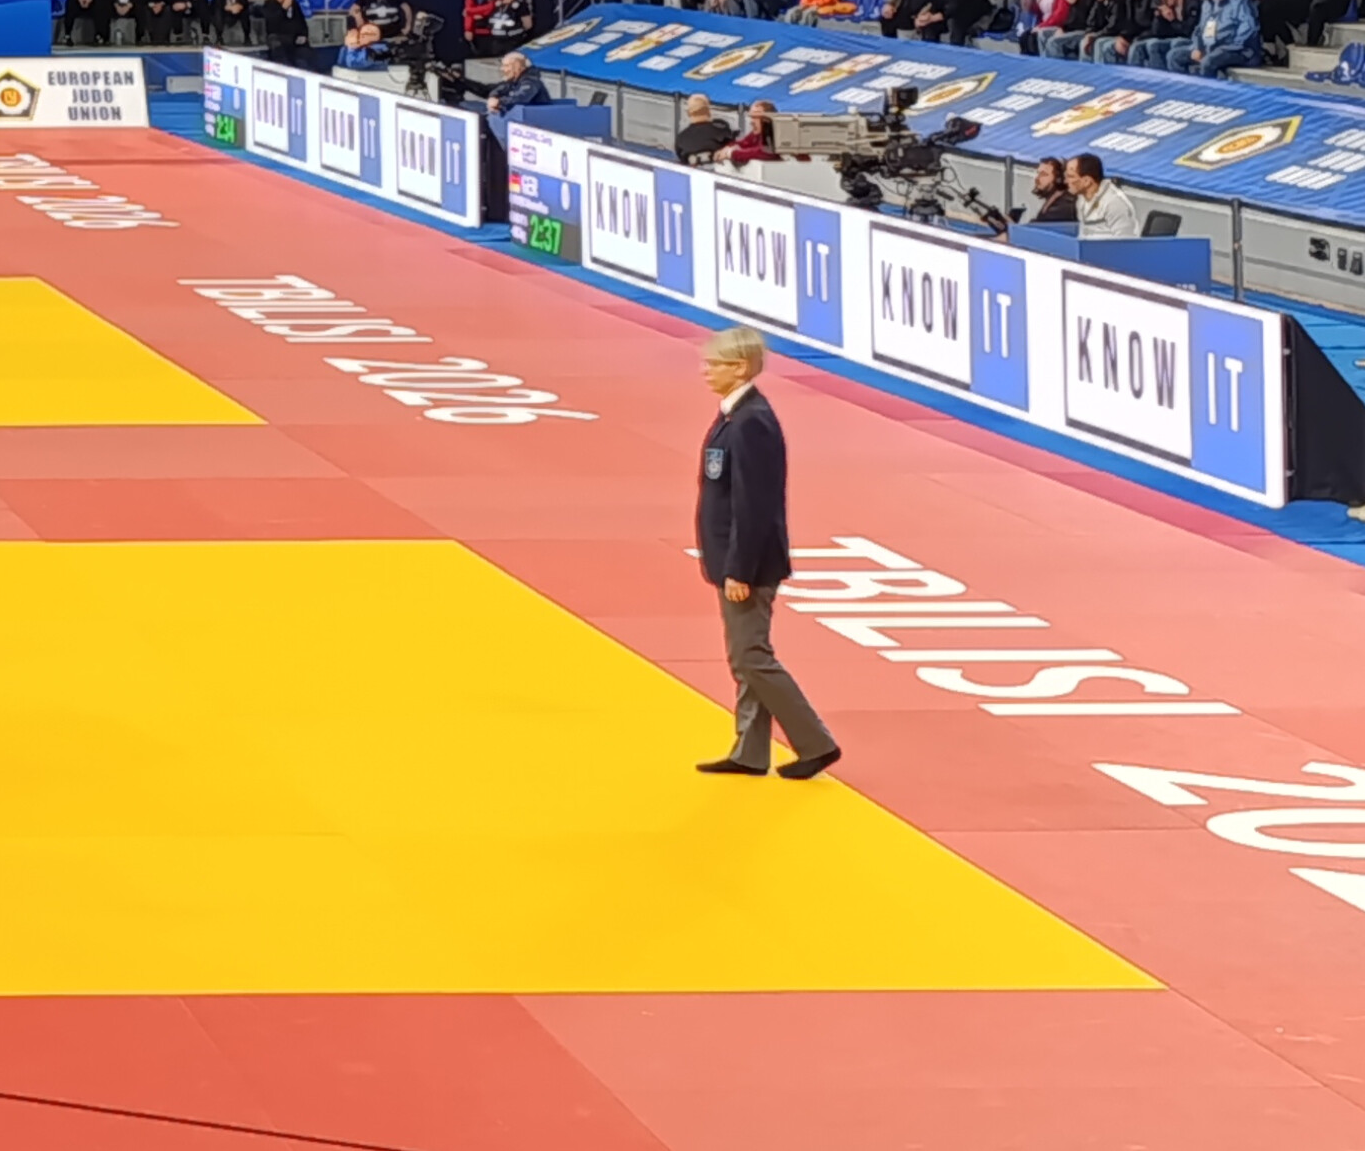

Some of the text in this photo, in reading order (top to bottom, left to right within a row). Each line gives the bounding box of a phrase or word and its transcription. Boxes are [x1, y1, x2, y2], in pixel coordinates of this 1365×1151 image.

[47, 70, 135, 87] EUROPEAN
[67, 105, 123, 122] UNION
[72, 88, 114, 104] JUDO
[400, 128, 461, 185] KNOW IT
[529, 214, 562, 255] 2:37
[595, 181, 649, 244] KNOW
[663, 197, 685, 256] IT
[722, 217, 830, 302] KNOW IT
[880, 260, 1012, 359] KNOW IT
[175, 273, 601, 425] TBILISI 2026
[1078, 315, 1244, 433] KNOW IT
[685, 535, 1244, 717] TBILISI
